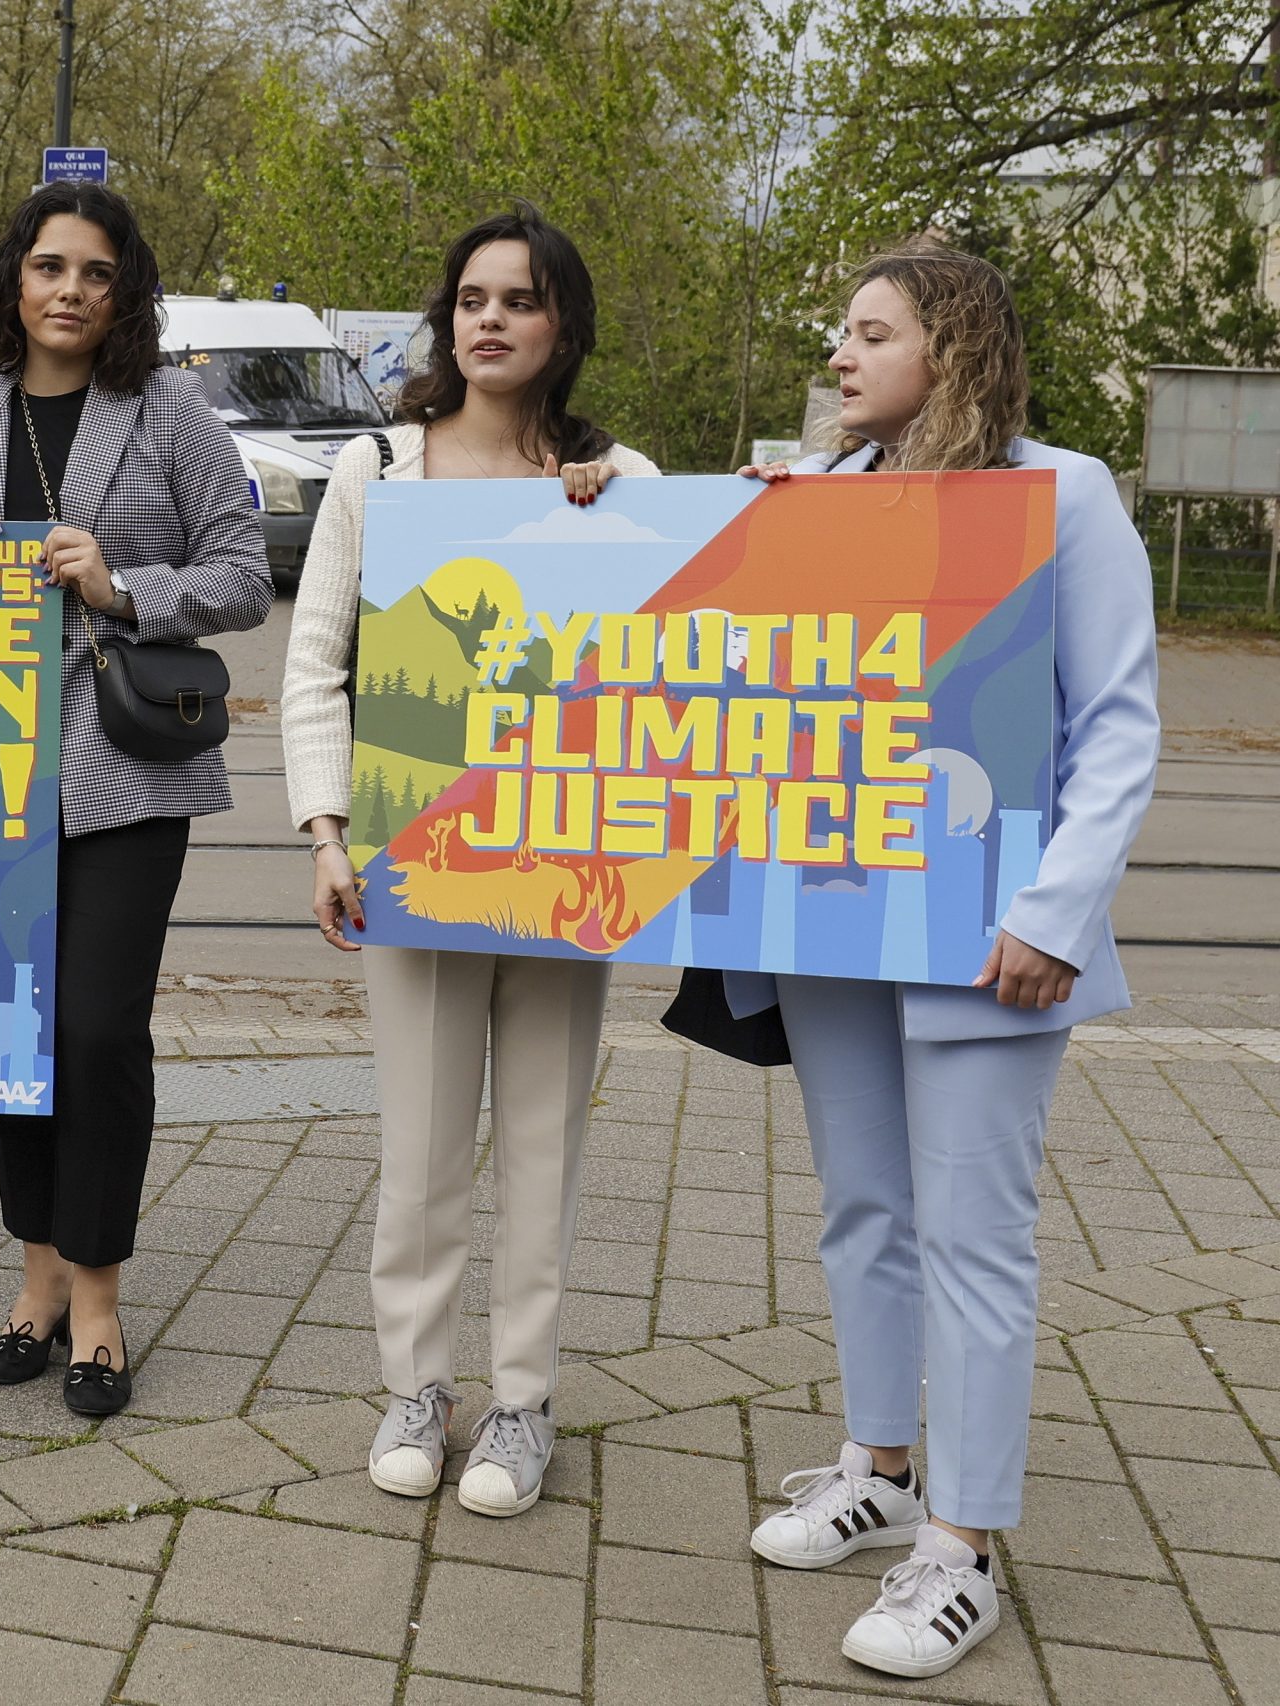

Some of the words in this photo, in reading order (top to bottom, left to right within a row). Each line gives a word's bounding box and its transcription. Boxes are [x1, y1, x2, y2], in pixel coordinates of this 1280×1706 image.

[48, 162, 77, 171] ERNEST
[78, 162, 102, 171] BEVIN
[65, 152, 86, 161] QUAI
[474, 611, 925, 688] #YOUTH4
[464, 691, 932, 783] CLIMATE
[459, 770, 929, 870] JUSTICE
